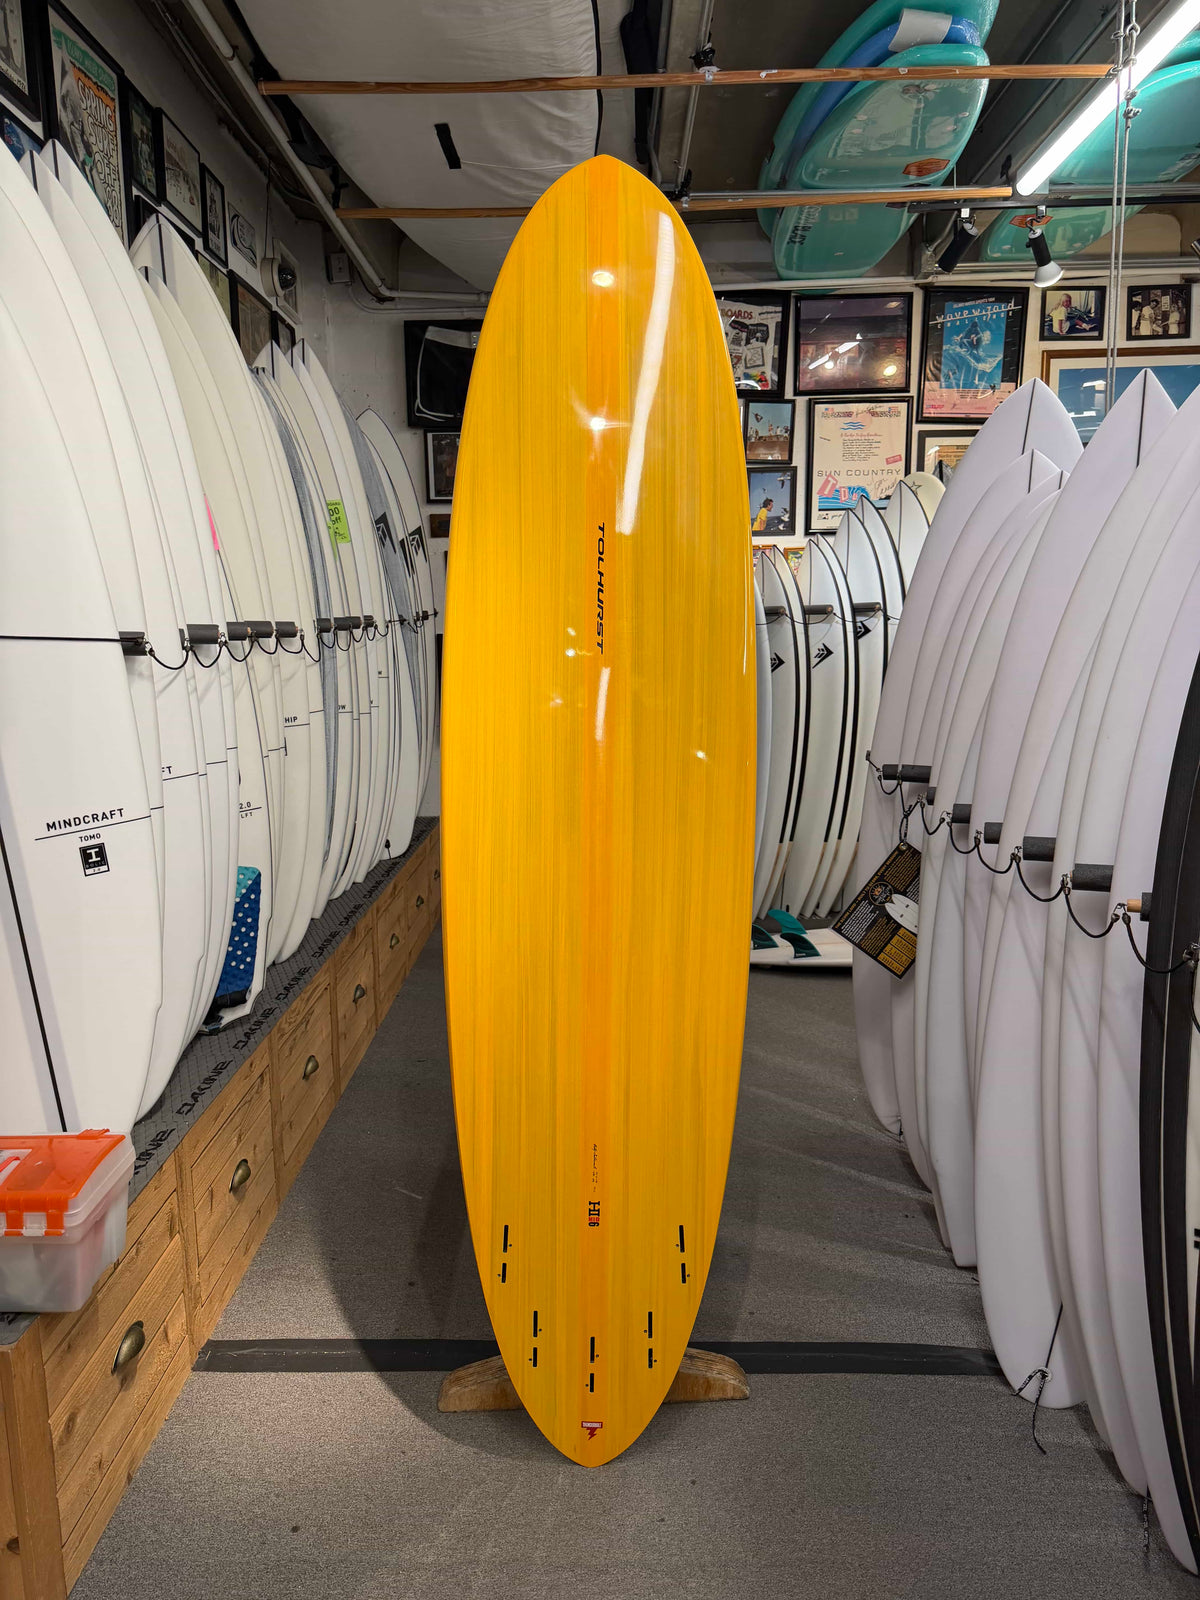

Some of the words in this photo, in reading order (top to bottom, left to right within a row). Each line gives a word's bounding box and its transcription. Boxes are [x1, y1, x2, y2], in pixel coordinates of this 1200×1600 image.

[78, 79, 115, 133] SPRING
[846, 468, 902, 477] COUNTRY
[596, 521, 605, 655] TOLHURST
[284, 716, 298, 724] HIP
[46, 808, 124, 832] MINDCRAFT
[239, 801, 252, 810] 2.0
[78, 832, 101, 842] TOMO
[311, 930, 341, 959] DAKINE
[275, 966, 312, 1000] DAKINE
[232, 1006, 278, 1050] DAKINE
[176, 1059, 233, 1116] DAKINE
